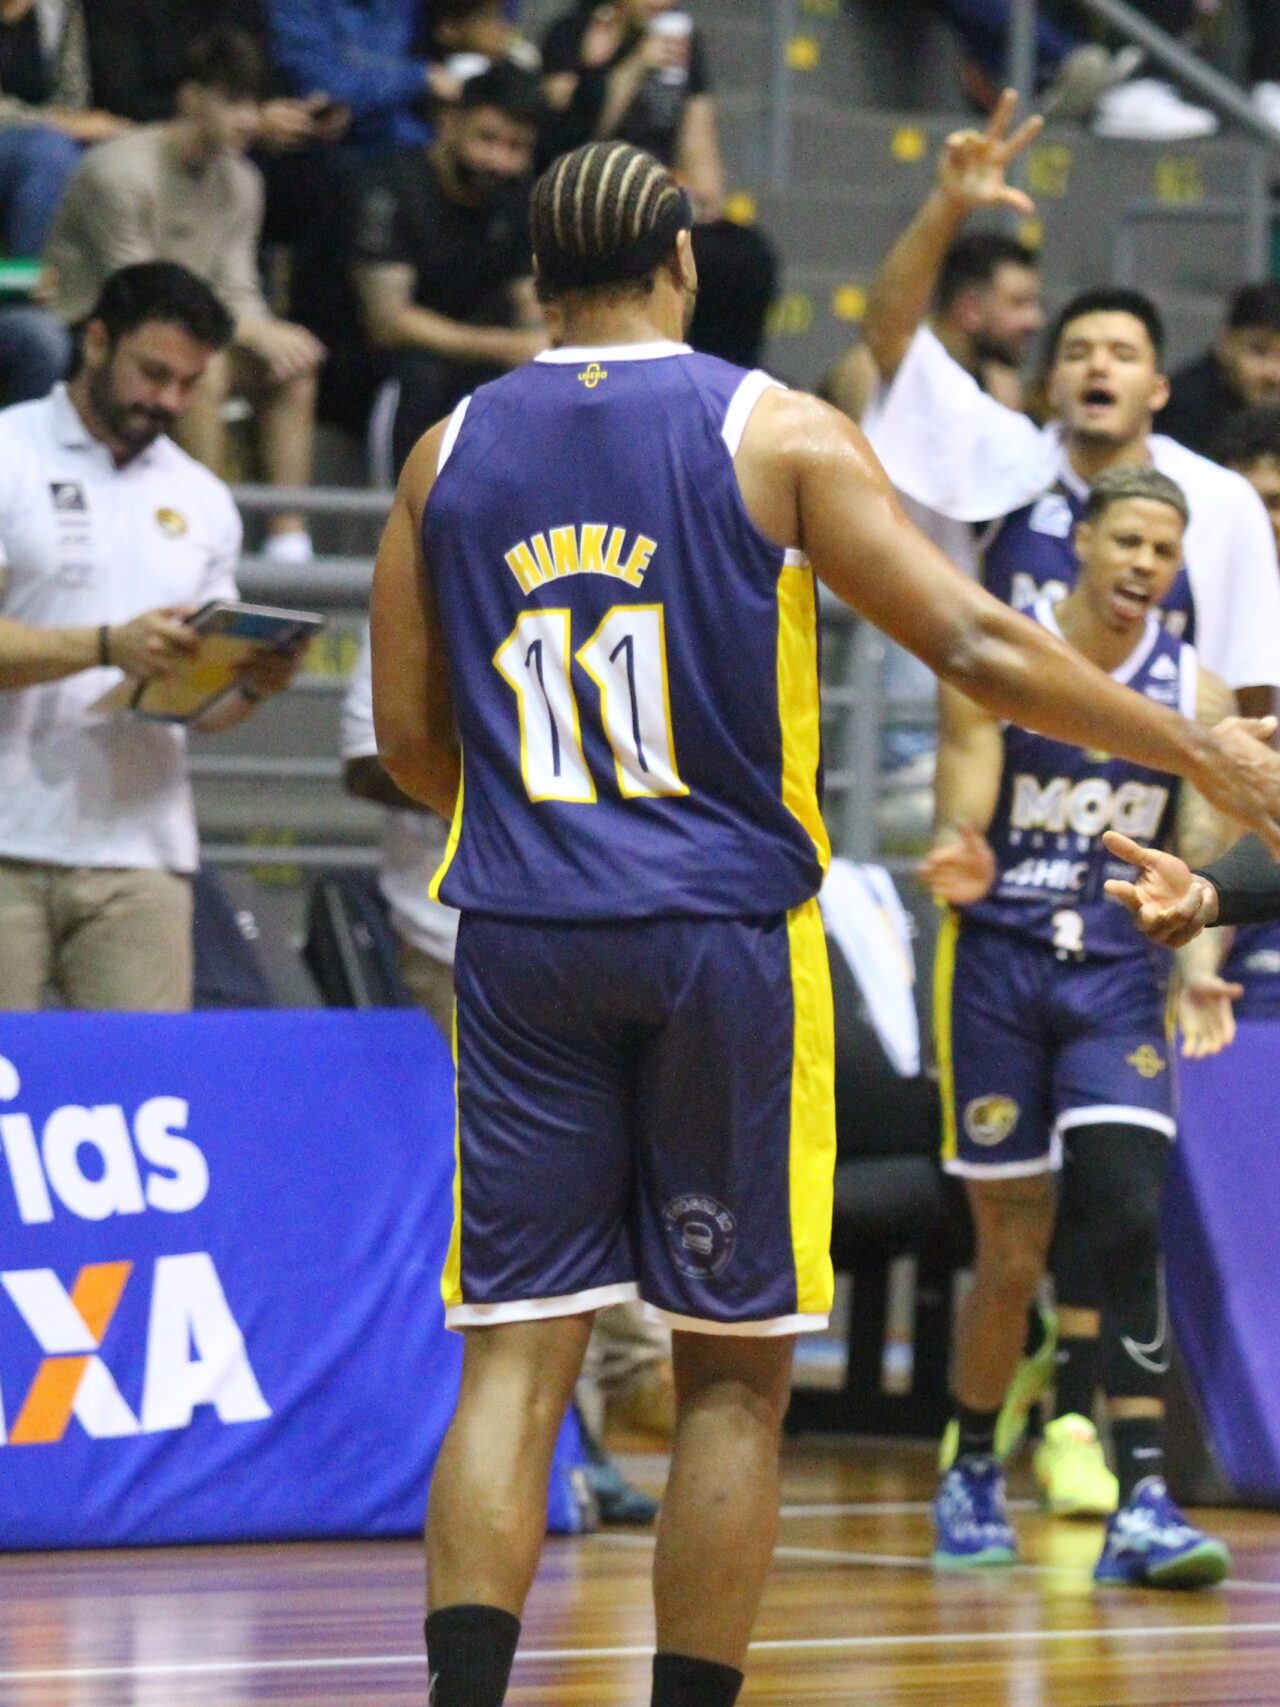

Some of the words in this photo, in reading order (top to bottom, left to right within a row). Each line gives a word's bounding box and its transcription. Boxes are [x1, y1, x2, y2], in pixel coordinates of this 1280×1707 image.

[504, 523, 658, 596] HINKLE
[492, 603, 691, 804] 11
[0, 1251, 272, 1447] XA
